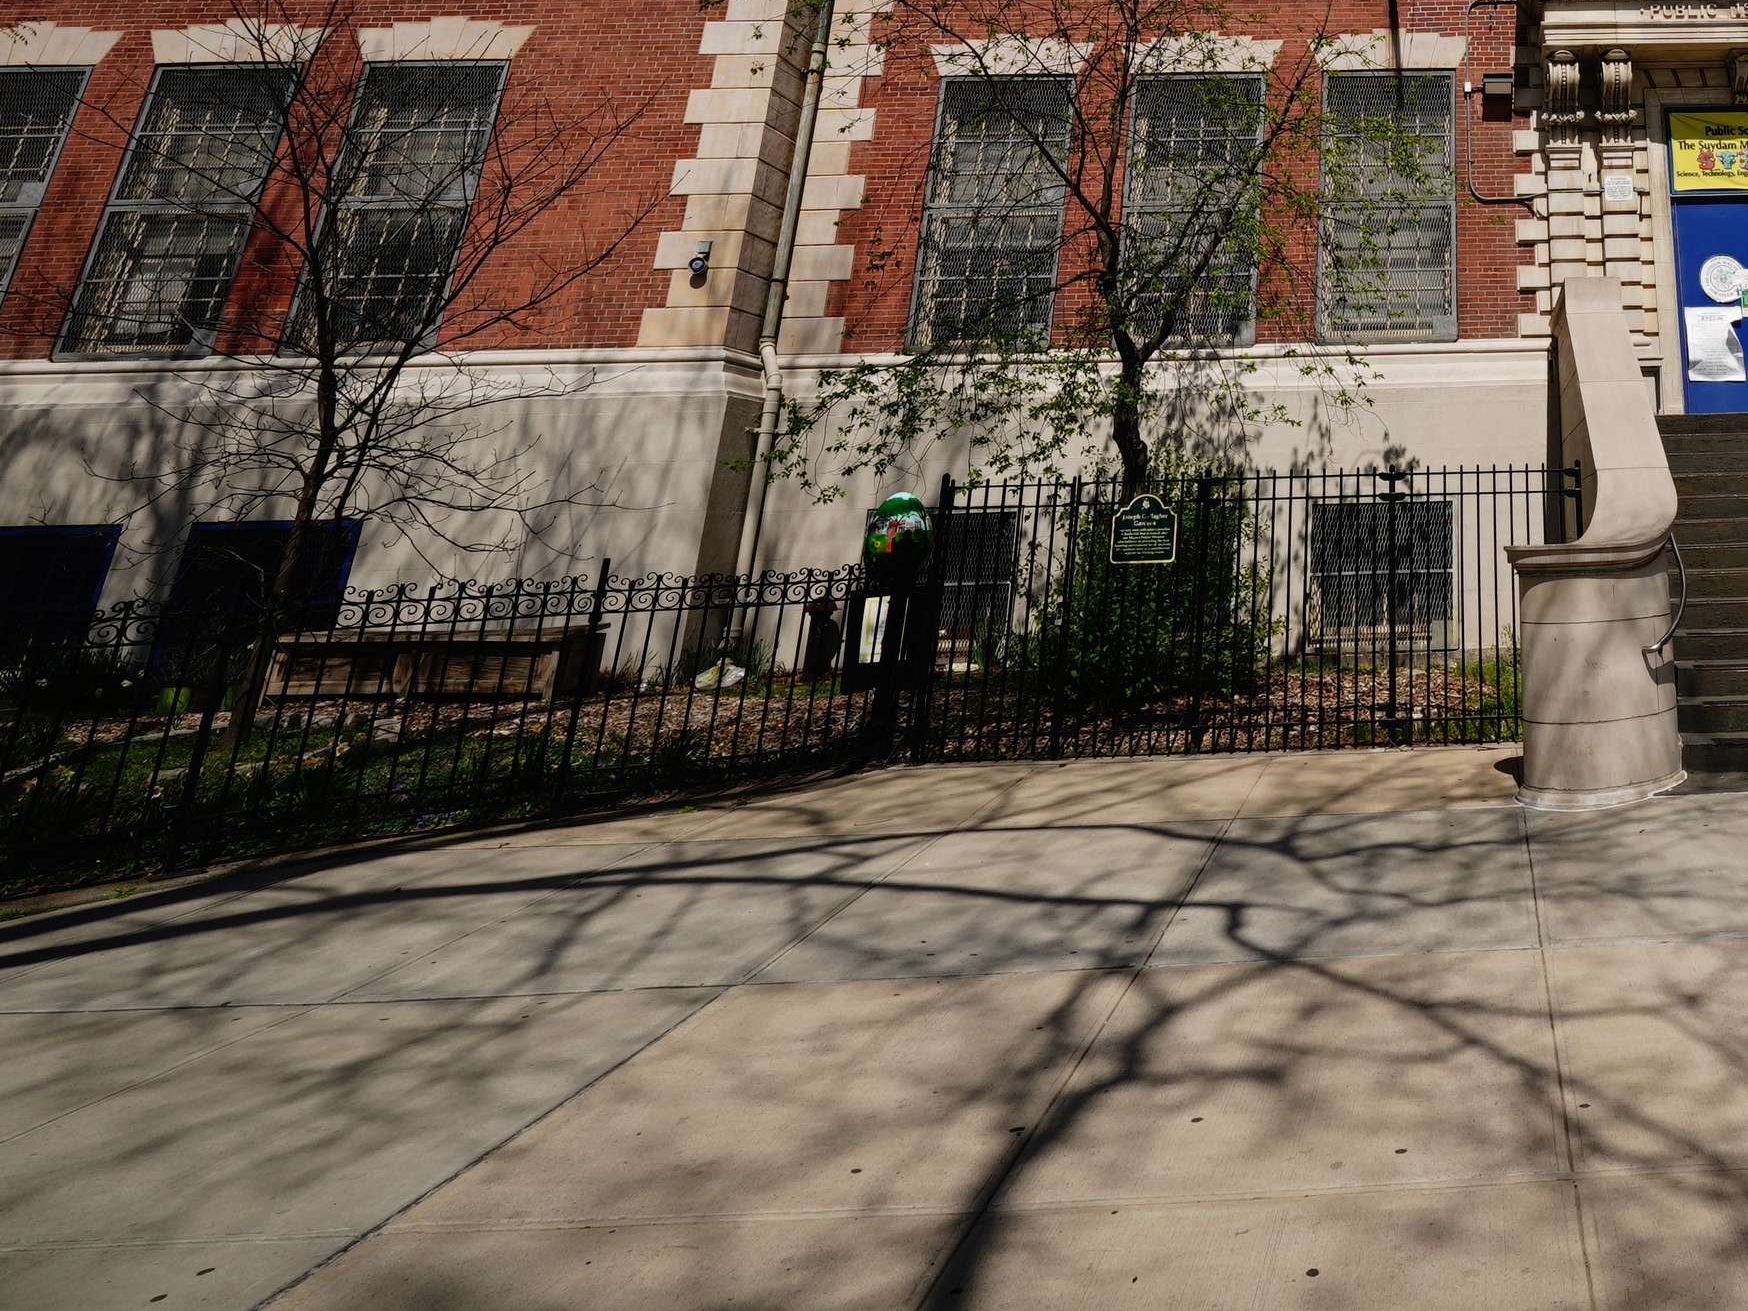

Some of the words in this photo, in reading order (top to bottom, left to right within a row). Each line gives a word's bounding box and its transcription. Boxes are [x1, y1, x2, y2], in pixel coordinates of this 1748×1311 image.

[1650, 4, 1718, 20] PUBLIC
[1705, 125, 1736, 136] Public
[1678, 139, 1696, 150] The
[1698, 139, 1737, 152] Suydam
